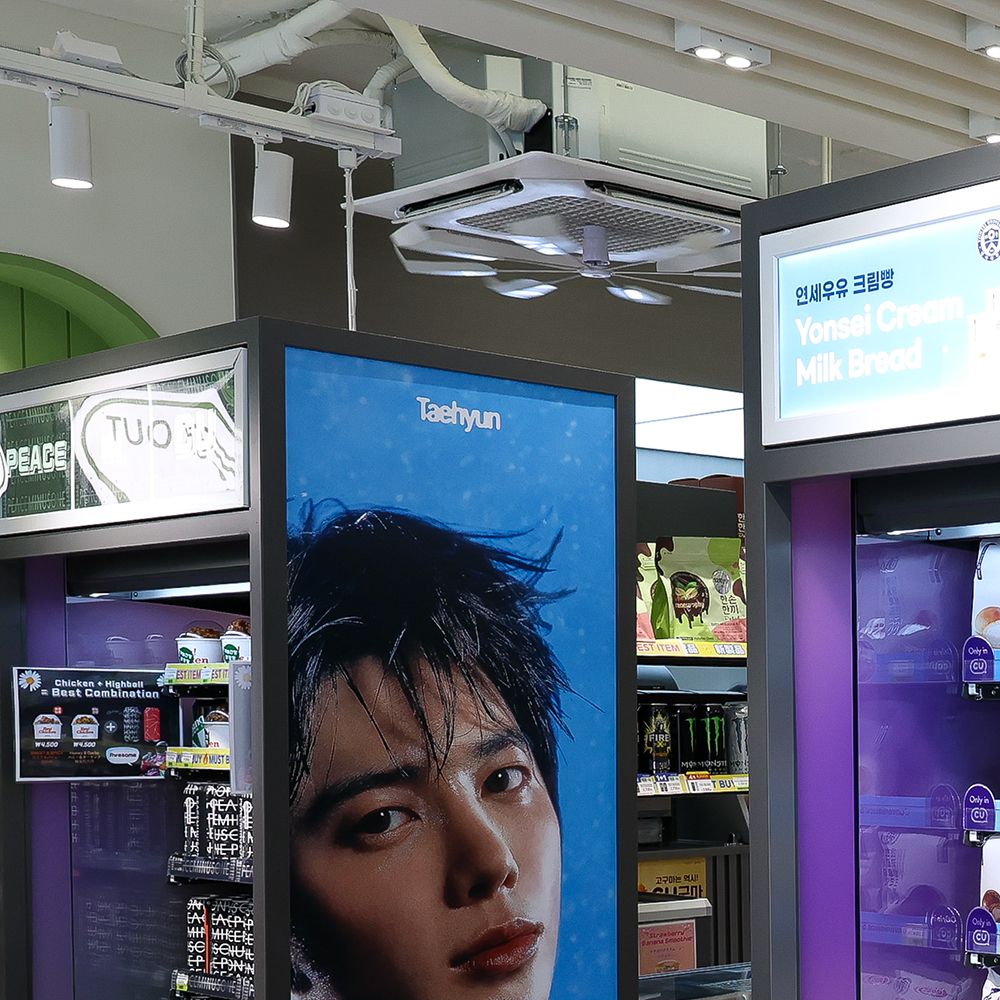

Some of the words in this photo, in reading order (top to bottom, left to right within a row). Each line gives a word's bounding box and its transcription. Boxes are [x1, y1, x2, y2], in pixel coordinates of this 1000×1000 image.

[795, 278, 848, 306] 연세우유
[853, 268, 894, 294] 크림빵
[795, 304, 872, 346] Yonsei
[876, 296, 964, 333] Cream
[796, 352, 843, 387] Milk
[848, 336, 923, 378] Bread
[416, 396, 501, 432] Taehyun
[6, 439, 68, 477] PEACE
[637, 643, 654, 652] EST
[657, 643, 680, 652] ITEM
[968, 647, 981, 656] Only
[105, 680, 144, 689] Highball
[52, 688, 82, 697] Best
[85, 688, 159, 698] Combination
[969, 795, 984, 805] Only
[656, 875, 681, 884] 고구마는
[972, 919, 985, 928] Only
